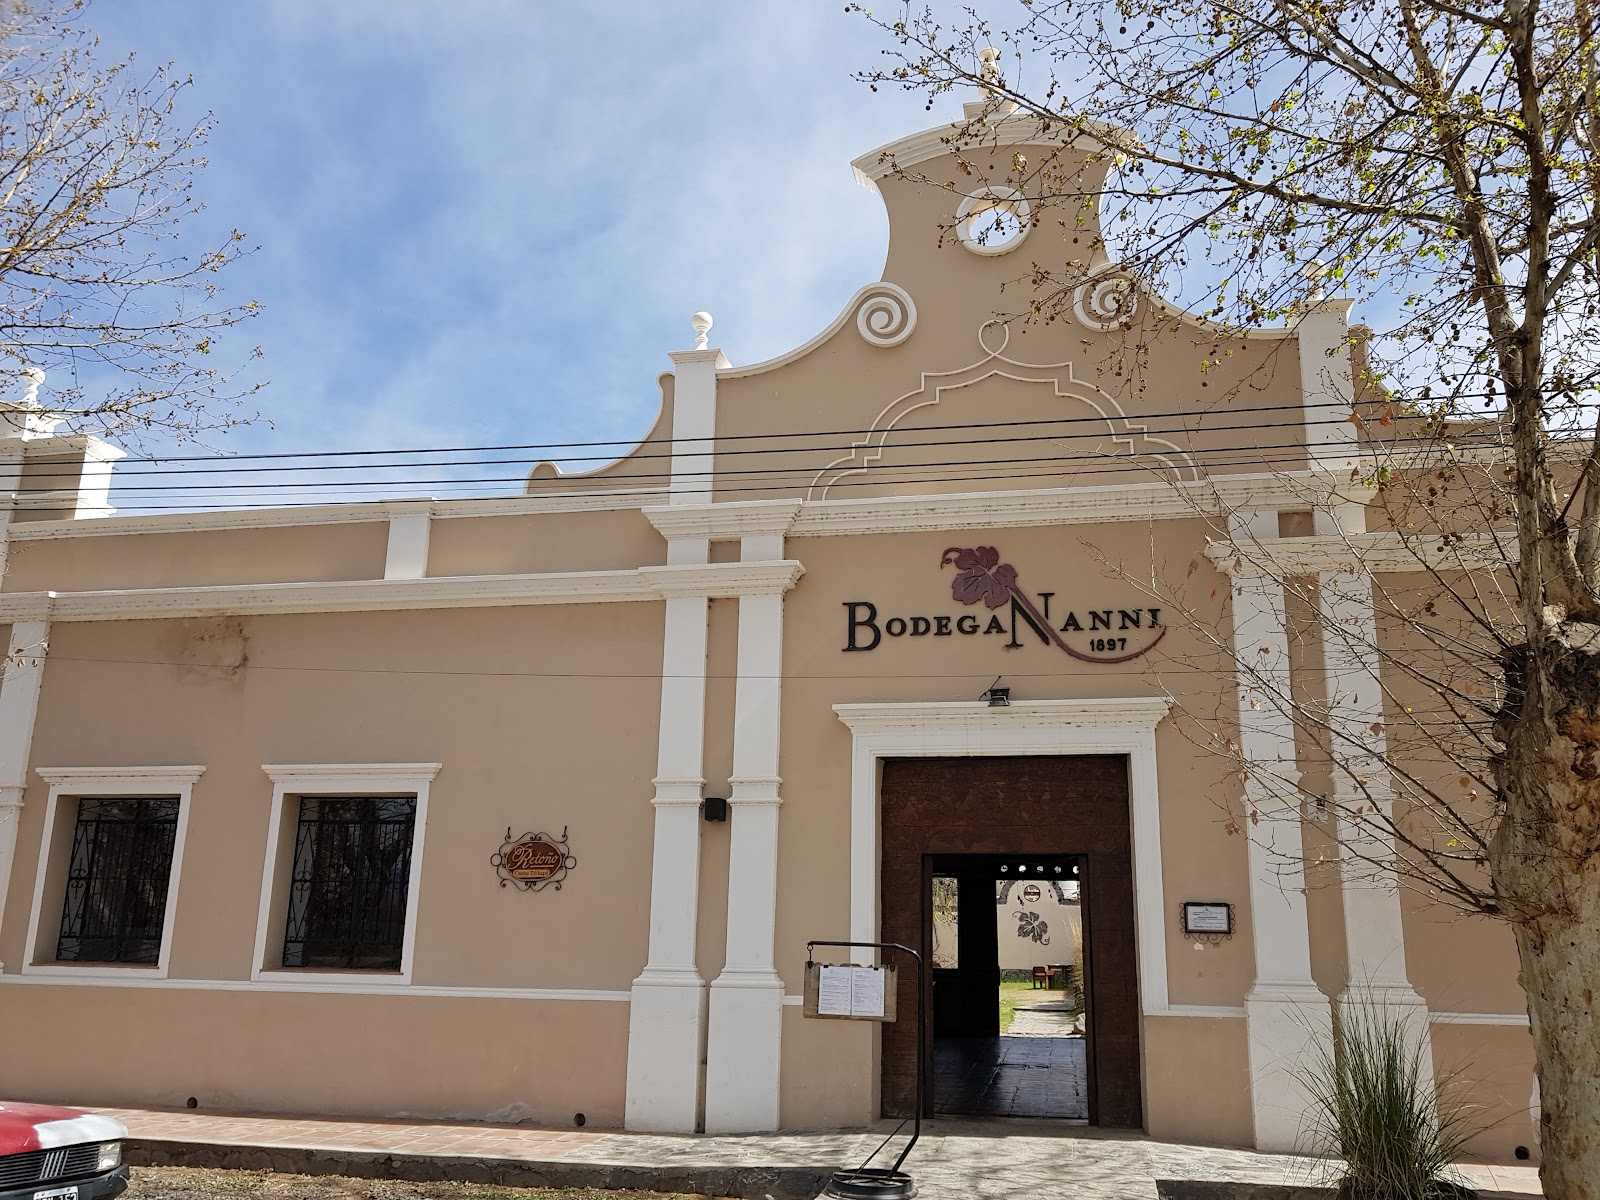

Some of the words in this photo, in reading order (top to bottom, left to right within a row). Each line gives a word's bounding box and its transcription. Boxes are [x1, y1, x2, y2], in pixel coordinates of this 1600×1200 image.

[841, 601, 1007, 652] BODEGA
[1005, 592, 1162, 648] NANNI
[1089, 637, 1128, 653] 1897
[508, 843, 559, 869] Retoño
